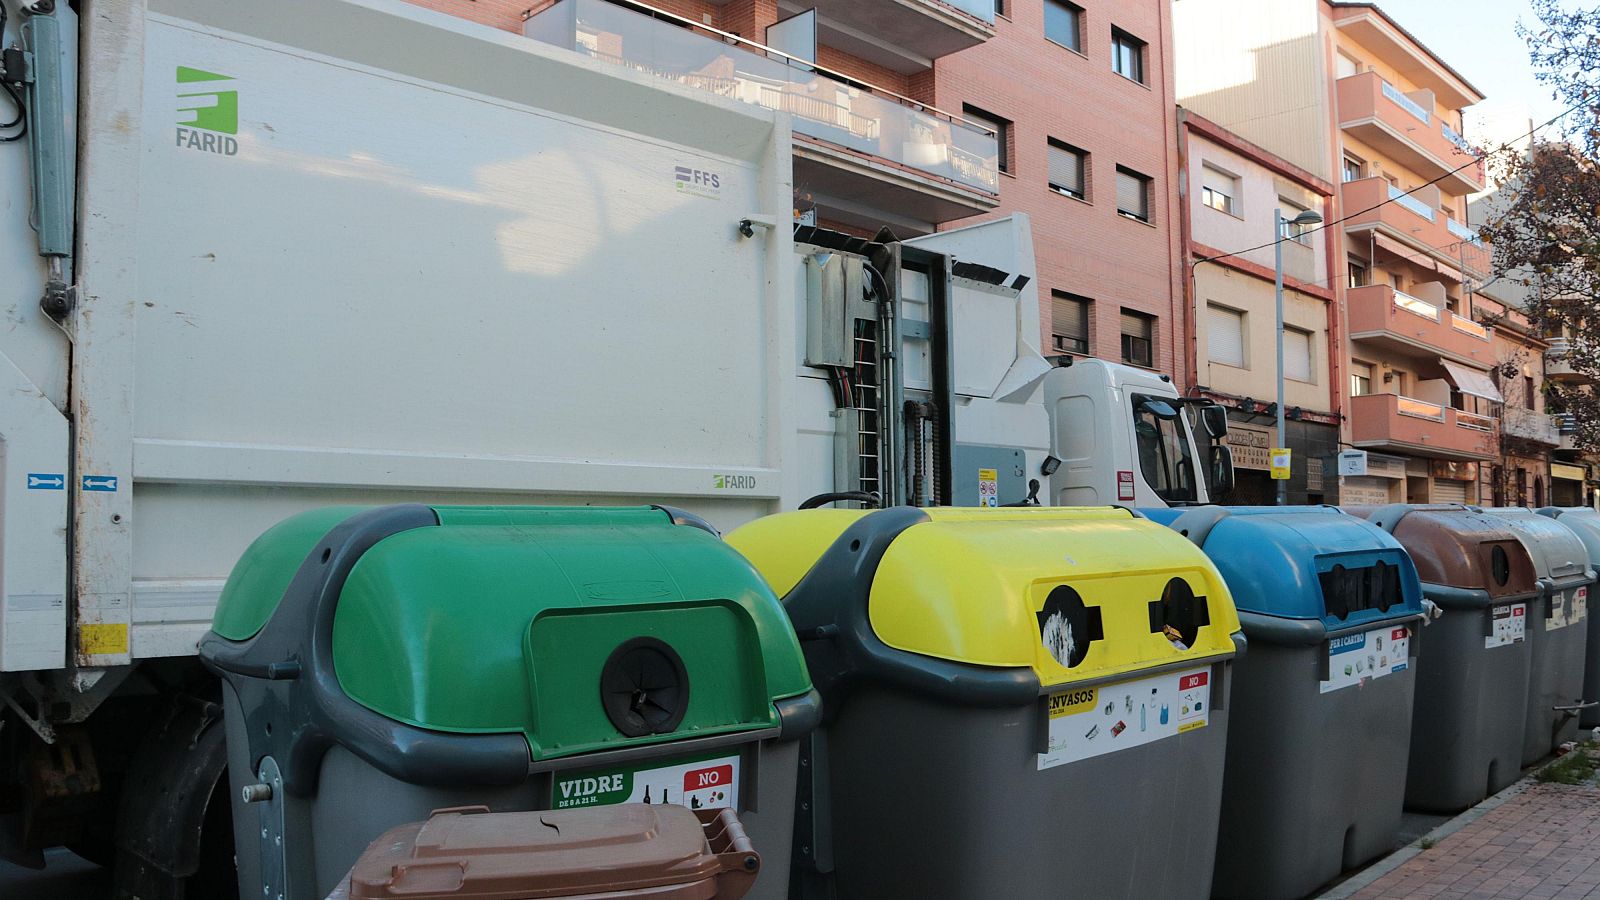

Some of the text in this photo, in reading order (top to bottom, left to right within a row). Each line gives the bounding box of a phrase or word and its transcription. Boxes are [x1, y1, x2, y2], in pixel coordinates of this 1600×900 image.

[176, 127, 238, 156] FARID
[693, 169, 720, 188] FFS
[724, 475, 756, 489] FARID
[1189, 676, 1199, 687] NO
[559, 773, 624, 799] VIDRE
[698, 771, 719, 786] NO
[559, 800, 569, 808] DE
